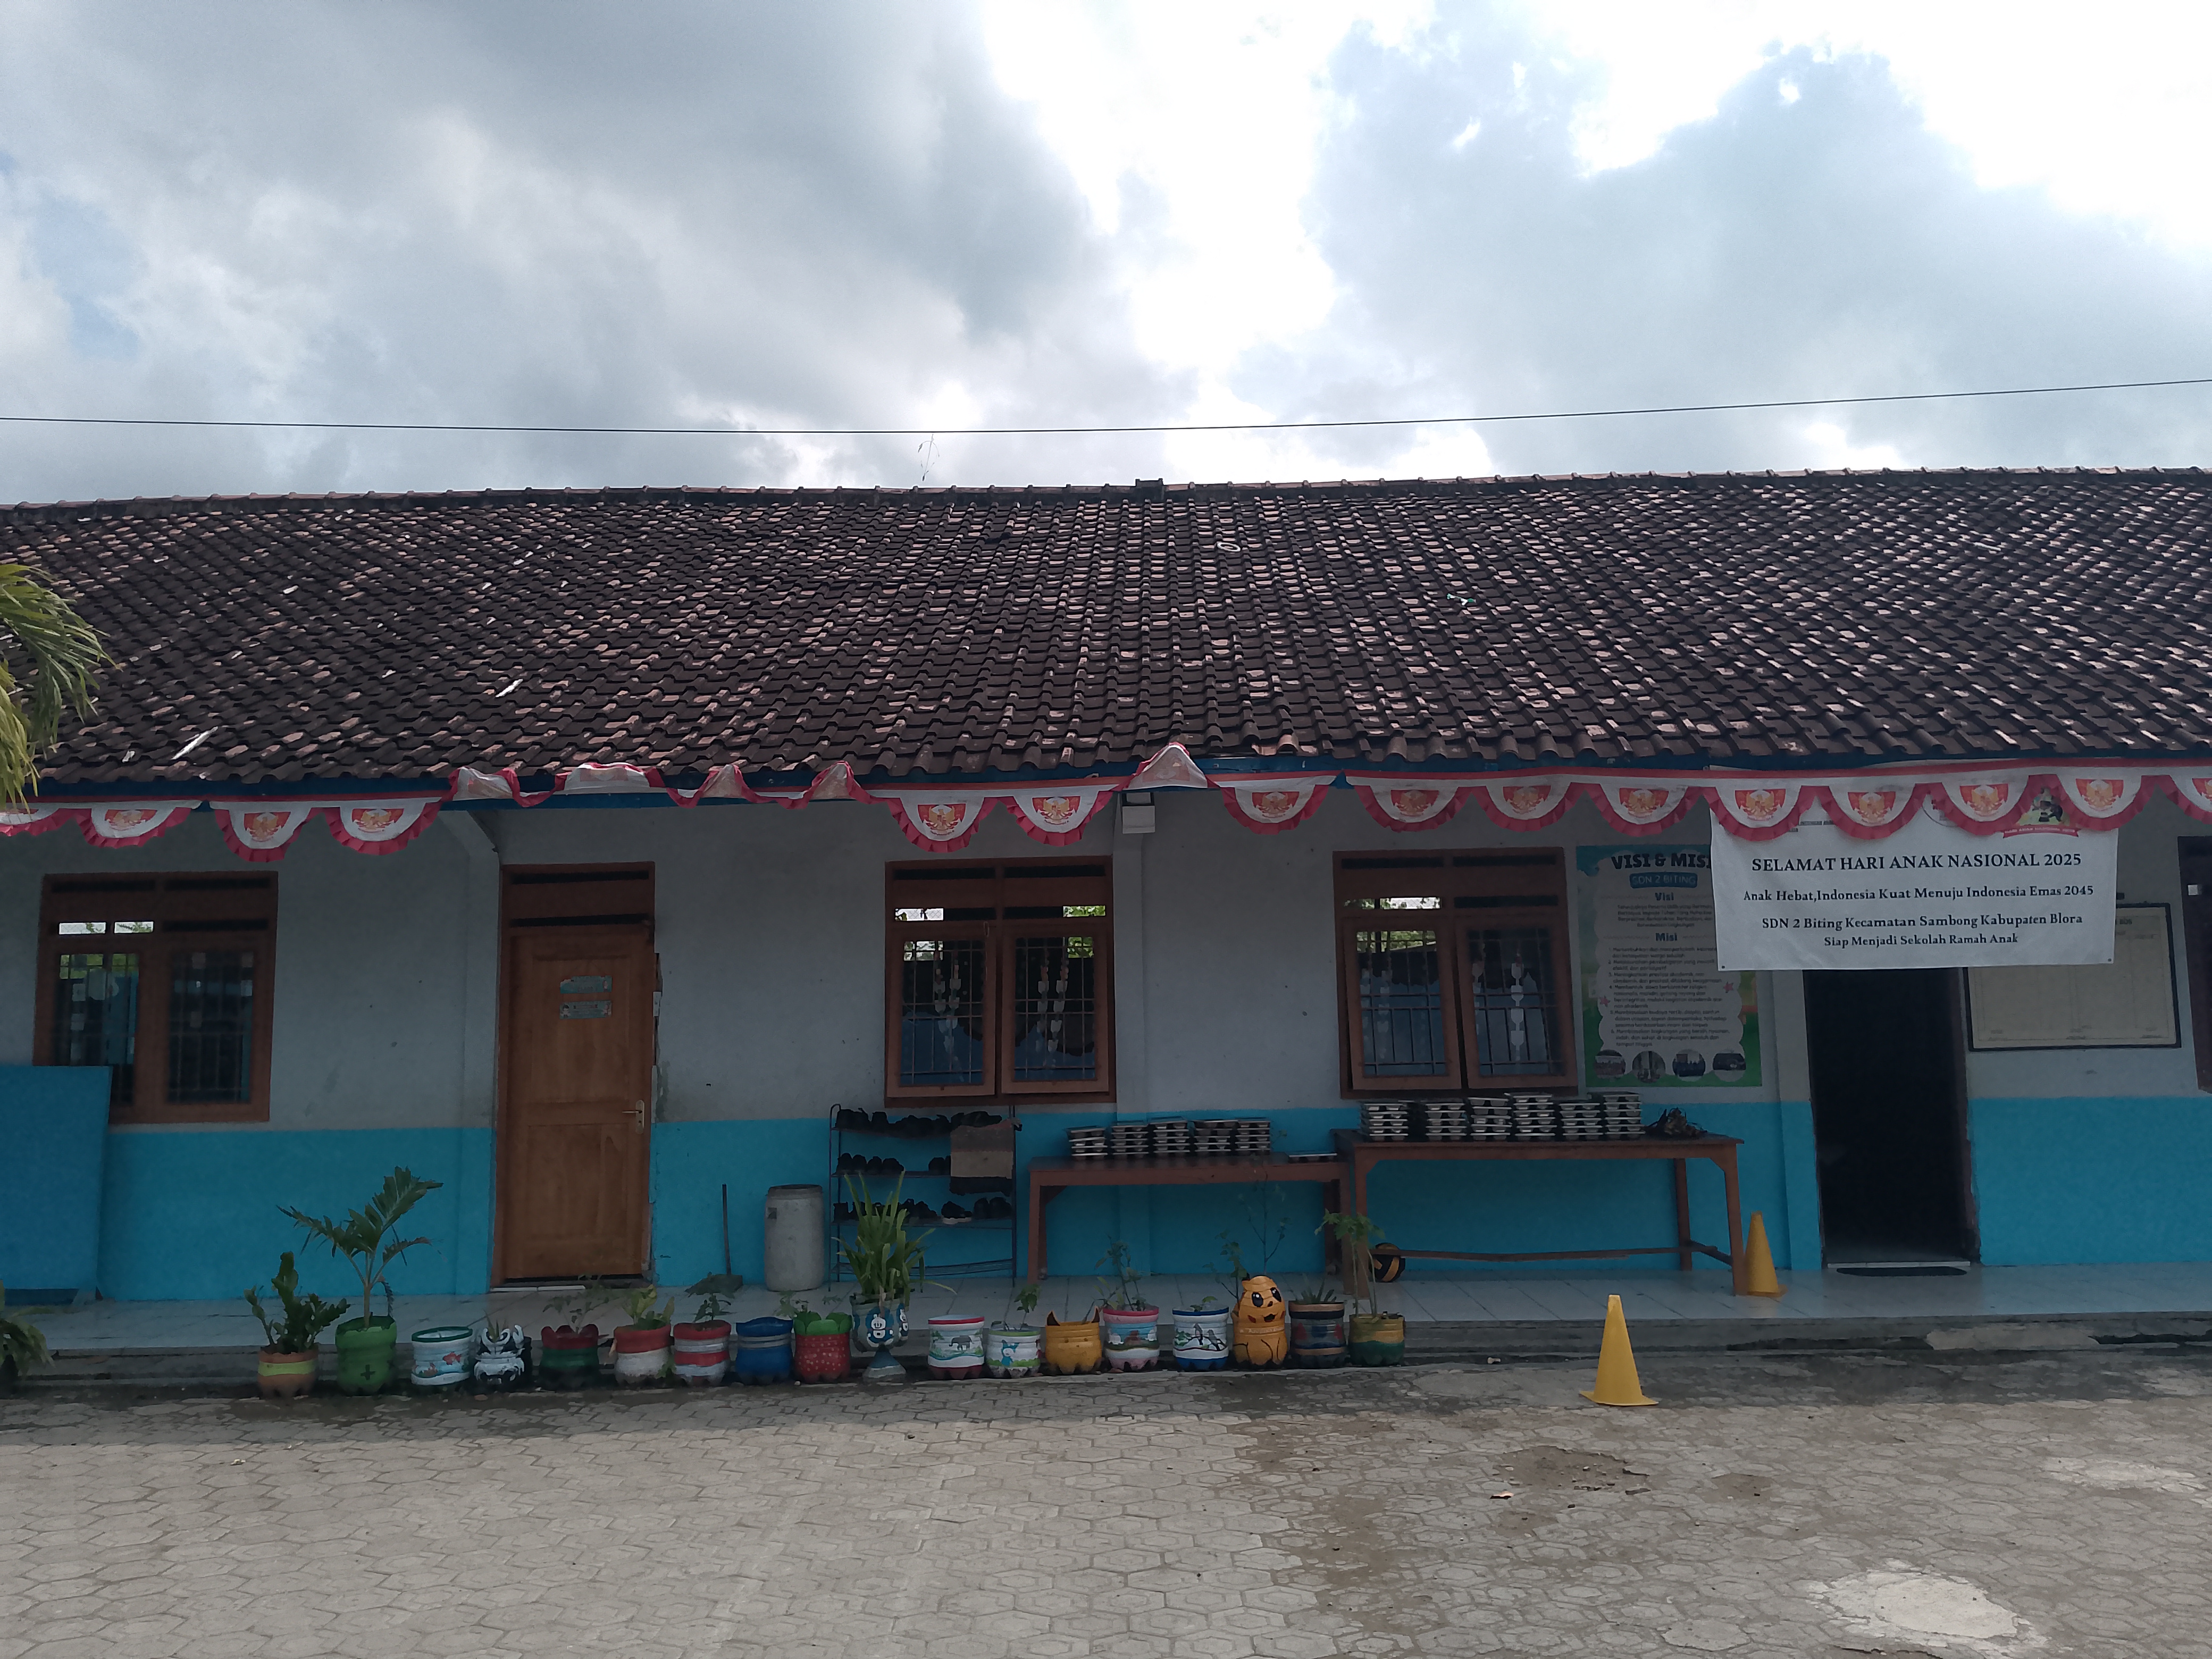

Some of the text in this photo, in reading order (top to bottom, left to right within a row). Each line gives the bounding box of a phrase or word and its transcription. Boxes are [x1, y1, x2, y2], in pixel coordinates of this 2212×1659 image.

[1611, 853, 1650, 869] VISI
[1655, 853, 1666, 867] &
[1752, 853, 2081, 871] SELAMAT HARI ANAK NASIONAL 2025
[1663, 875, 1696, 885] BITING
[1744, 890, 1772, 901] Anak
[1879, 889, 1911, 899] Kuat
[1914, 887, 1963, 900] Menuju
[1966, 886, 2026, 898] Indonesia
[2030, 886, 2061, 896] Emas
[2064, 885, 2093, 896] 2045
[1762, 912, 2083, 931] SDN 2 Biting Kecamatan Sambong Kabupaten Blora
[1655, 933, 1678, 942] Misi
[1824, 933, 2018, 949] Siap Menjadi Sekolah Ramah Anak
